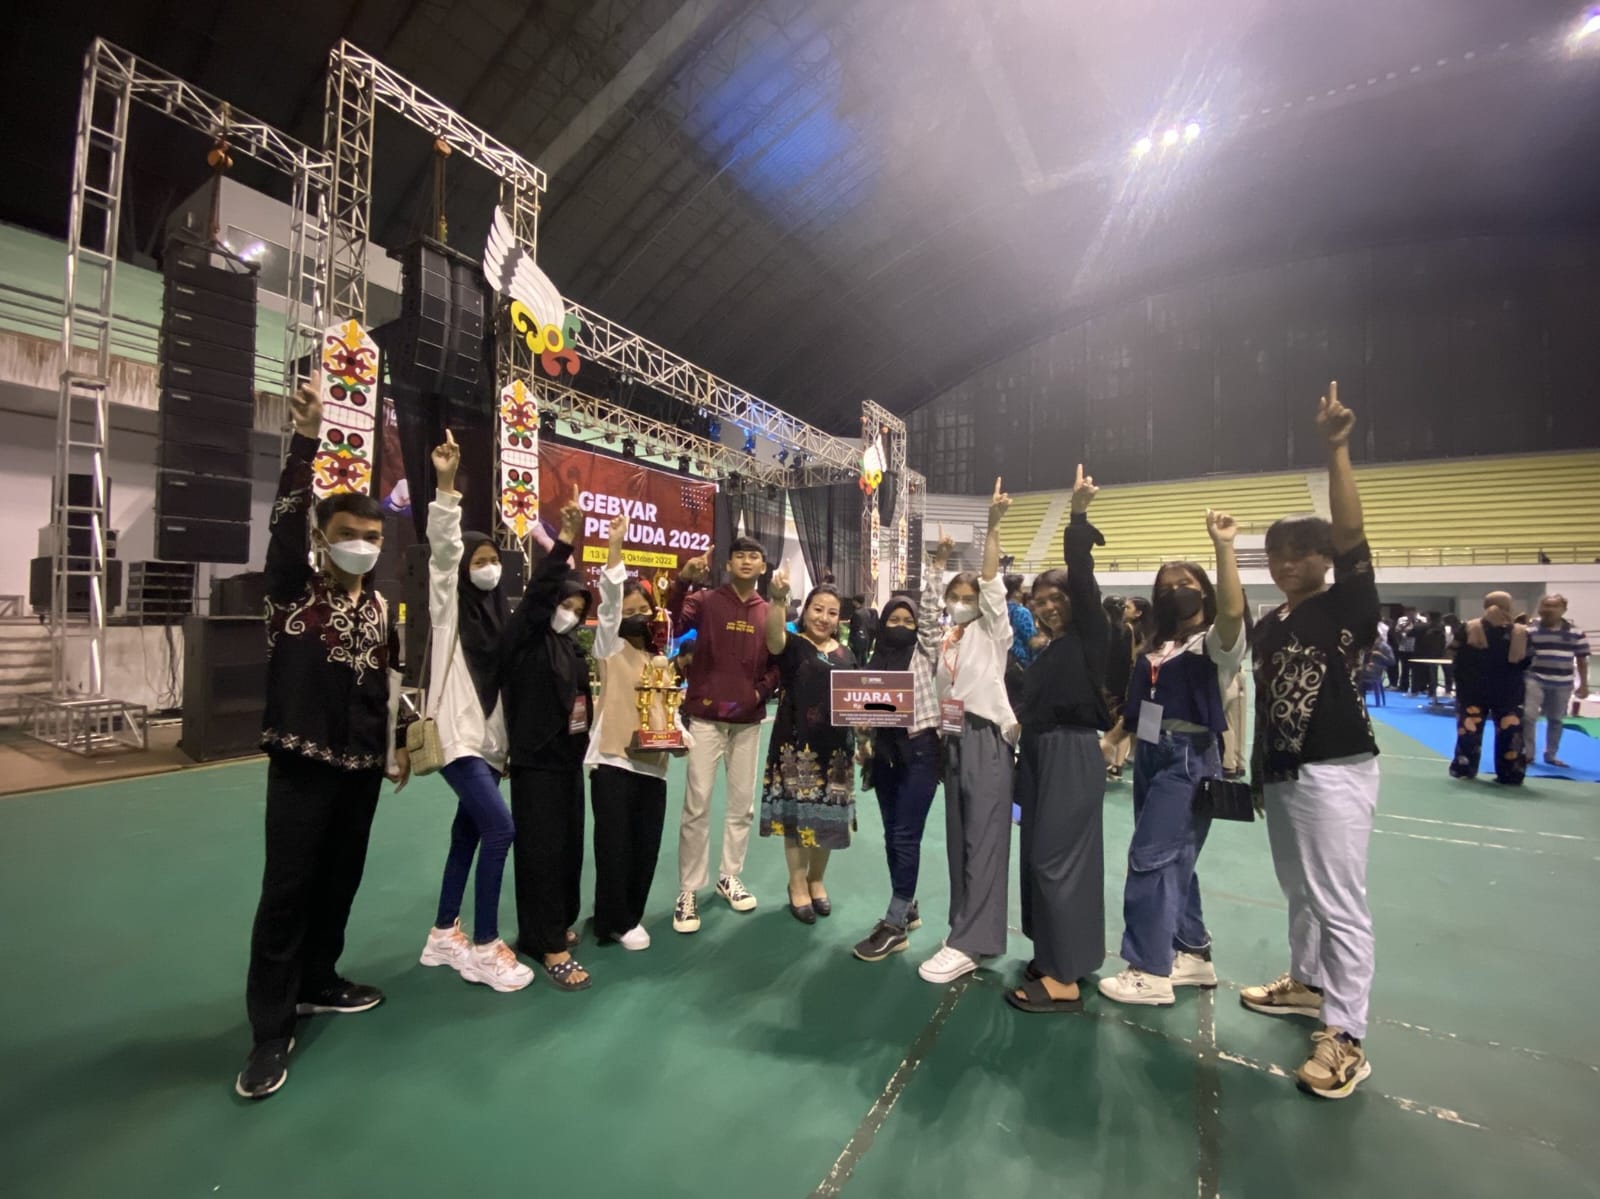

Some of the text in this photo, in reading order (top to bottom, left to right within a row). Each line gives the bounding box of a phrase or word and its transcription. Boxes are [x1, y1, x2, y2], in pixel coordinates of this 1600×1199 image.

[578, 491, 658, 522] GEBYAR
[584, 517, 711, 551] PEUDA 2022
[590, 550, 600, 559] 13
[627, 553, 654, 563] Oktober
[655, 556, 673, 565] 2022
[843, 691, 904, 703] JUARA 1
